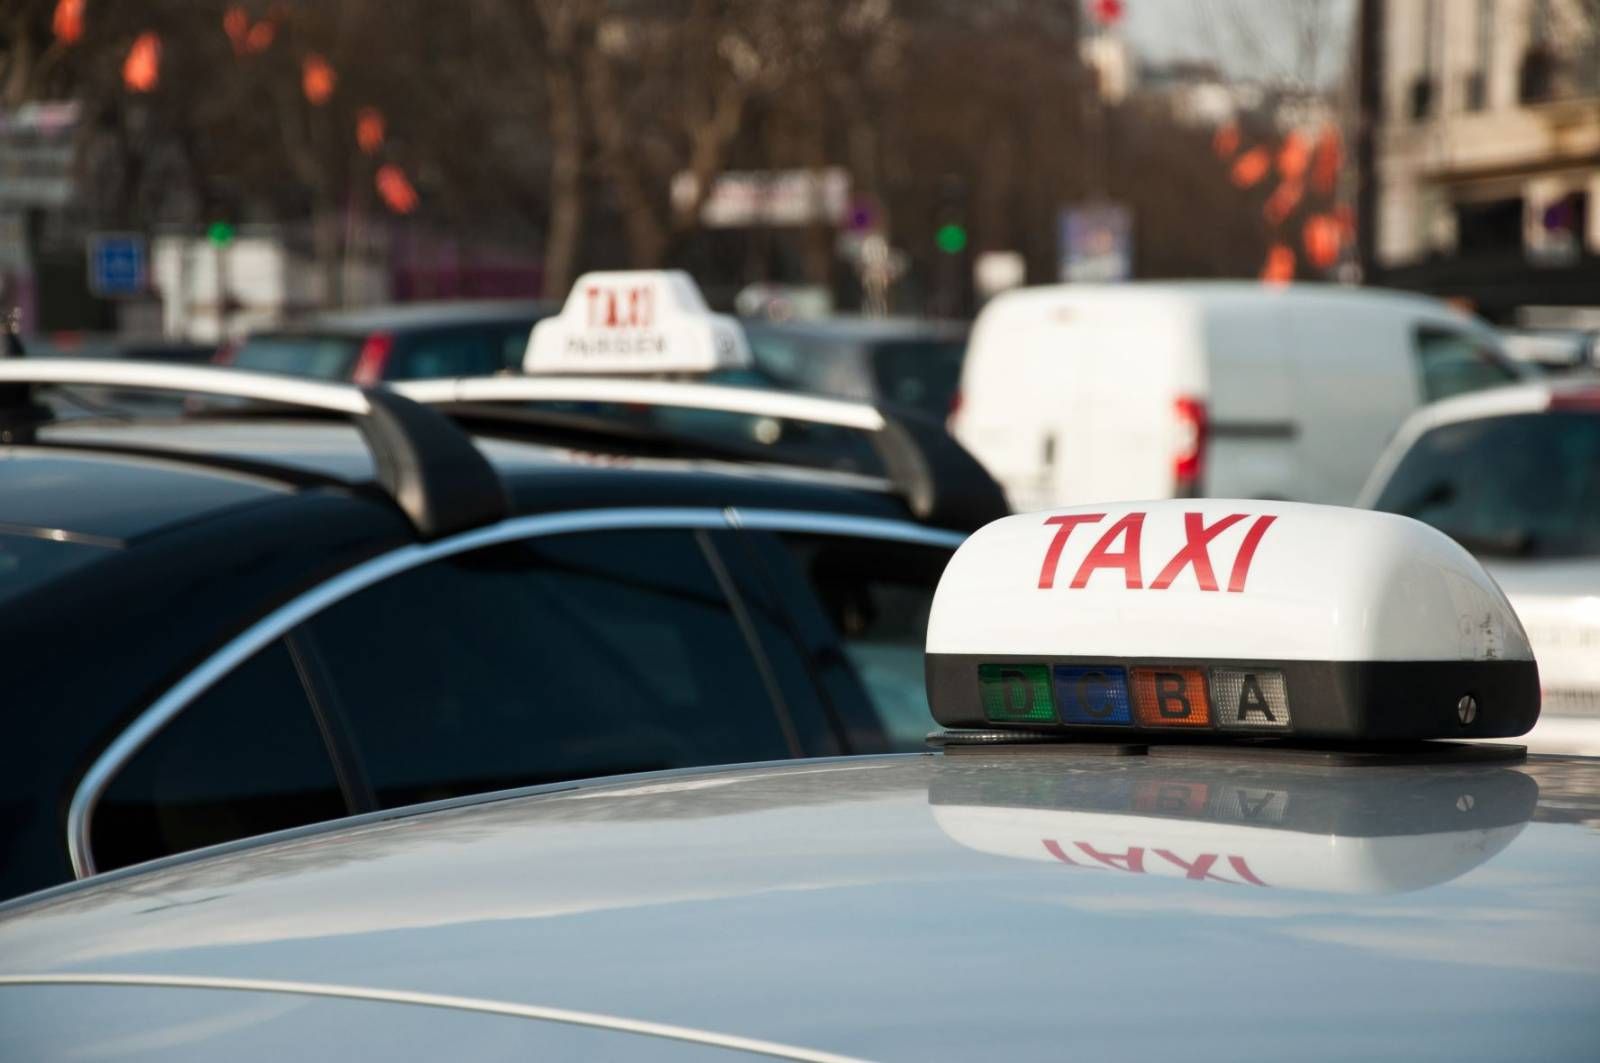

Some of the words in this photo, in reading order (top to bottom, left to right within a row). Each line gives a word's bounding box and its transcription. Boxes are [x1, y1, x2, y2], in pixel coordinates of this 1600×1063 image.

[586, 284, 656, 328] TAXI
[1038, 512, 1278, 592] TAXI
[1001, 671, 1035, 715] D
[1076, 672, 1113, 719] C
[1155, 672, 1191, 719] B
[1237, 674, 1277, 721] A
